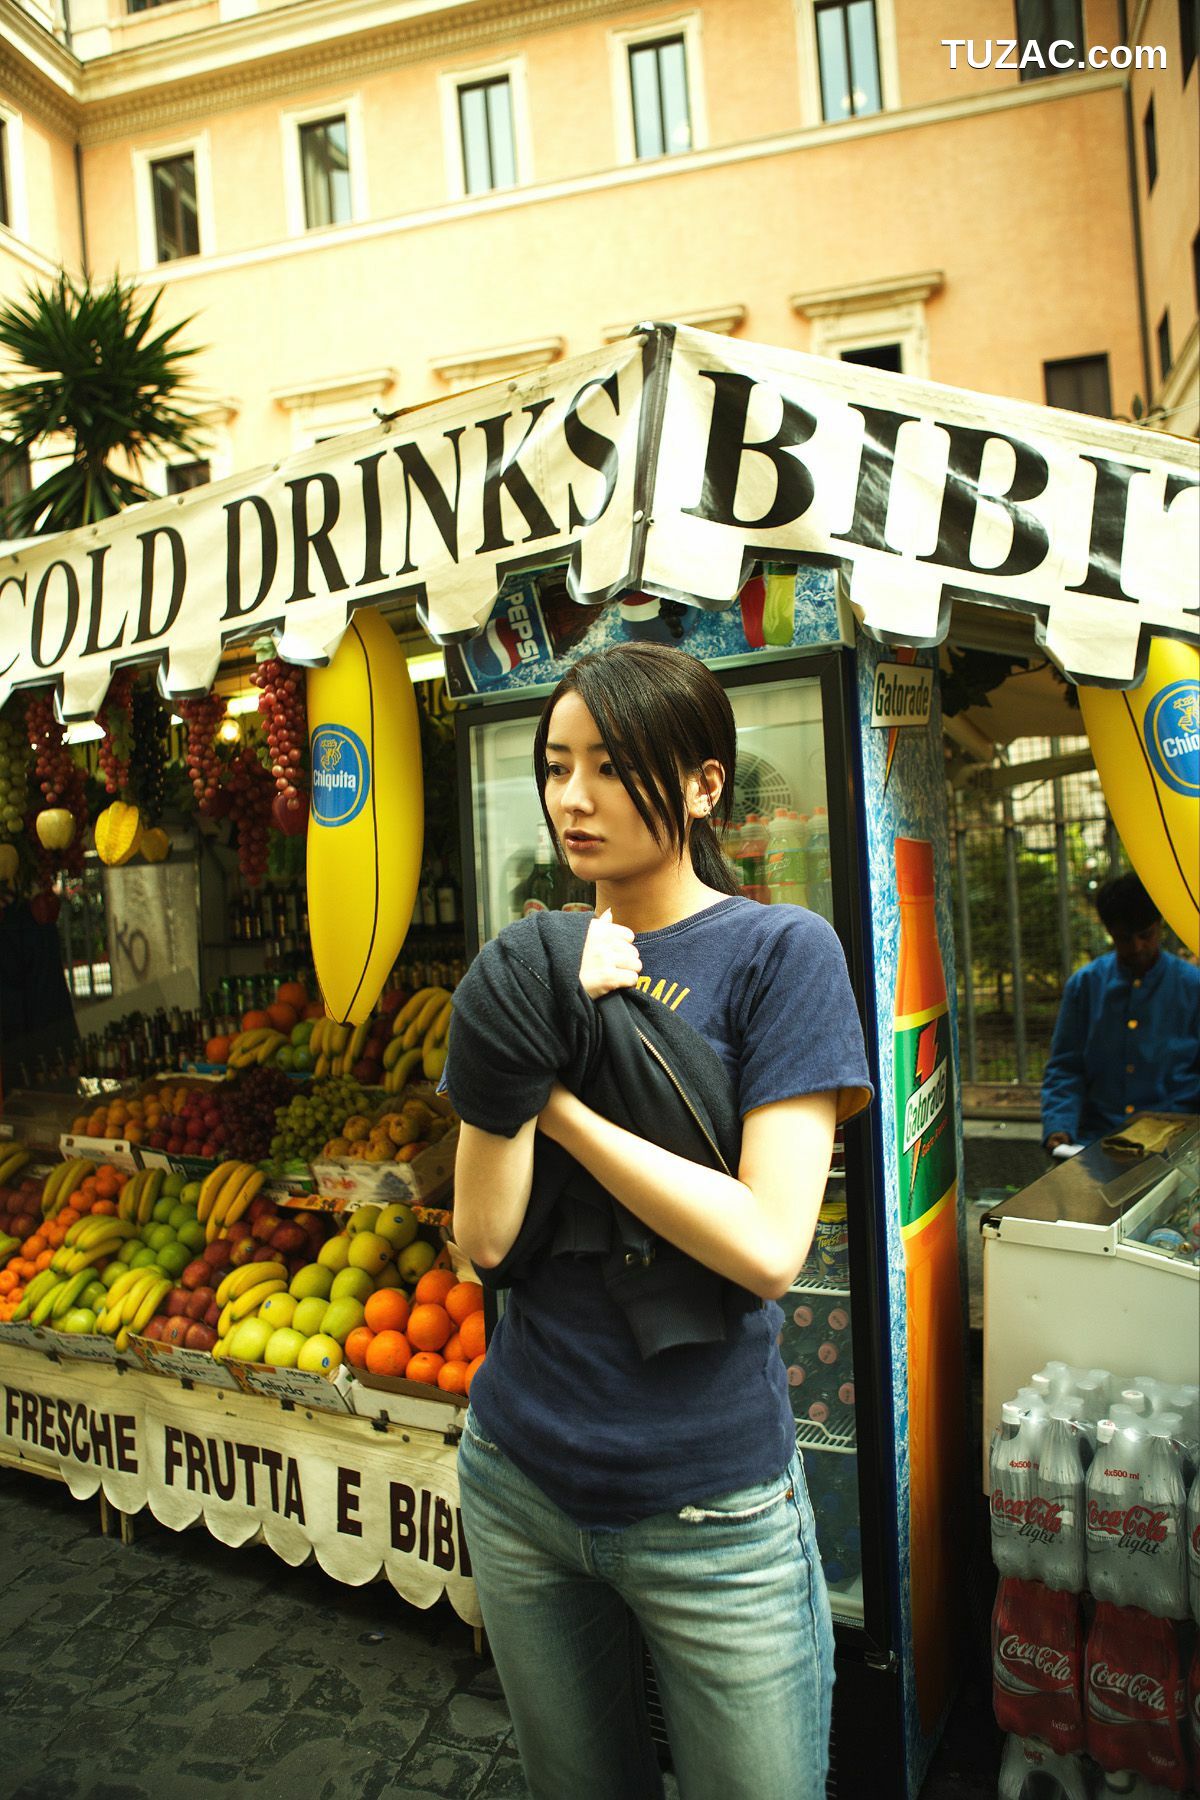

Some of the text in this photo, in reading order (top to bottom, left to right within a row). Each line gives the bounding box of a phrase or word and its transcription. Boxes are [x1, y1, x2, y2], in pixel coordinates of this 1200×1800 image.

[220, 371, 621, 621] DRINKS
[503, 592, 541, 664] PEPSI
[875, 672, 930, 717] Gatorade
[313, 769, 357, 792] Chiquita
[905, 1068, 946, 1143] Gatorade
[4, 1384, 139, 1475] FRESCHE
[164, 1425, 306, 1526] FRUTTA
[336, 1466, 363, 1538] E
[1104, 1469, 1127, 1478] 4x500
[1017, 1523, 1055, 1545] light
[1117, 1533, 1160, 1558] light
